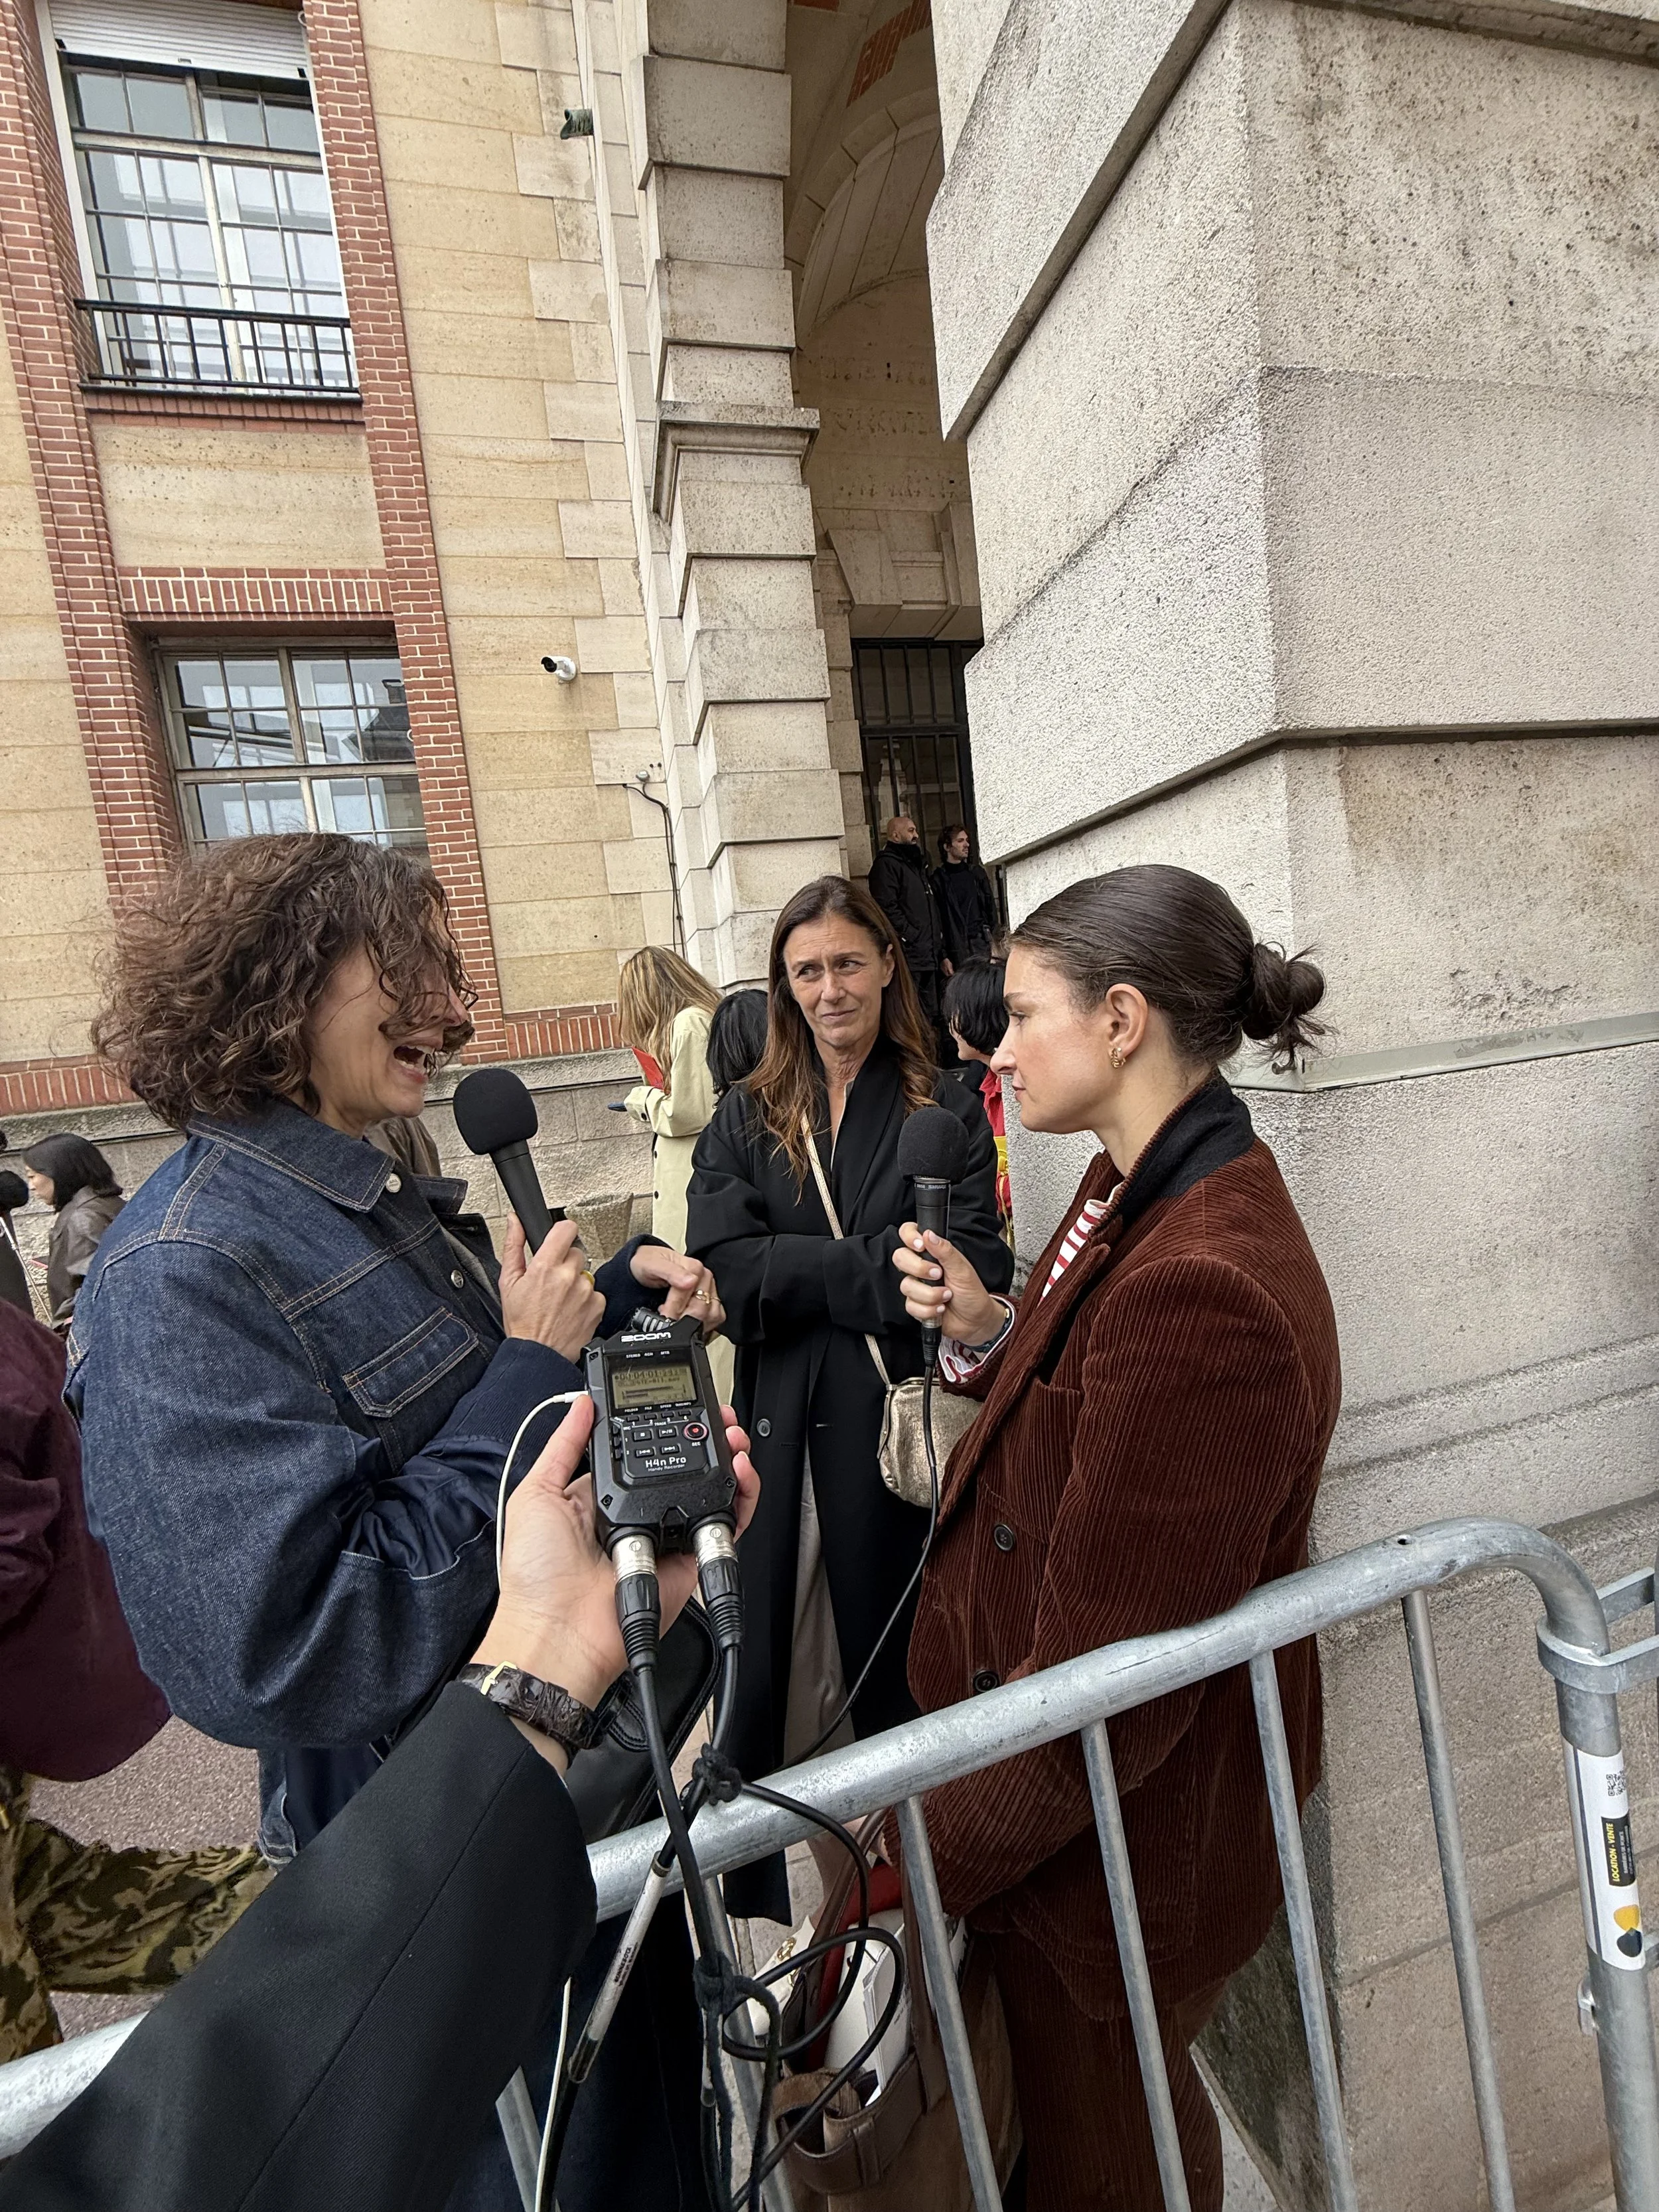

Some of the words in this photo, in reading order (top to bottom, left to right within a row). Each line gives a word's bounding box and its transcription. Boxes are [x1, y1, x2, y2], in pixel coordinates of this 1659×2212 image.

[621, 1332, 671, 1342] ZOOM
[645, 1458, 667, 1468] H4n
[669, 1456, 687, 1465] Pro
[1606, 1822, 1615, 1844] VENTE
[1609, 1848, 1620, 1881] LOCATION
